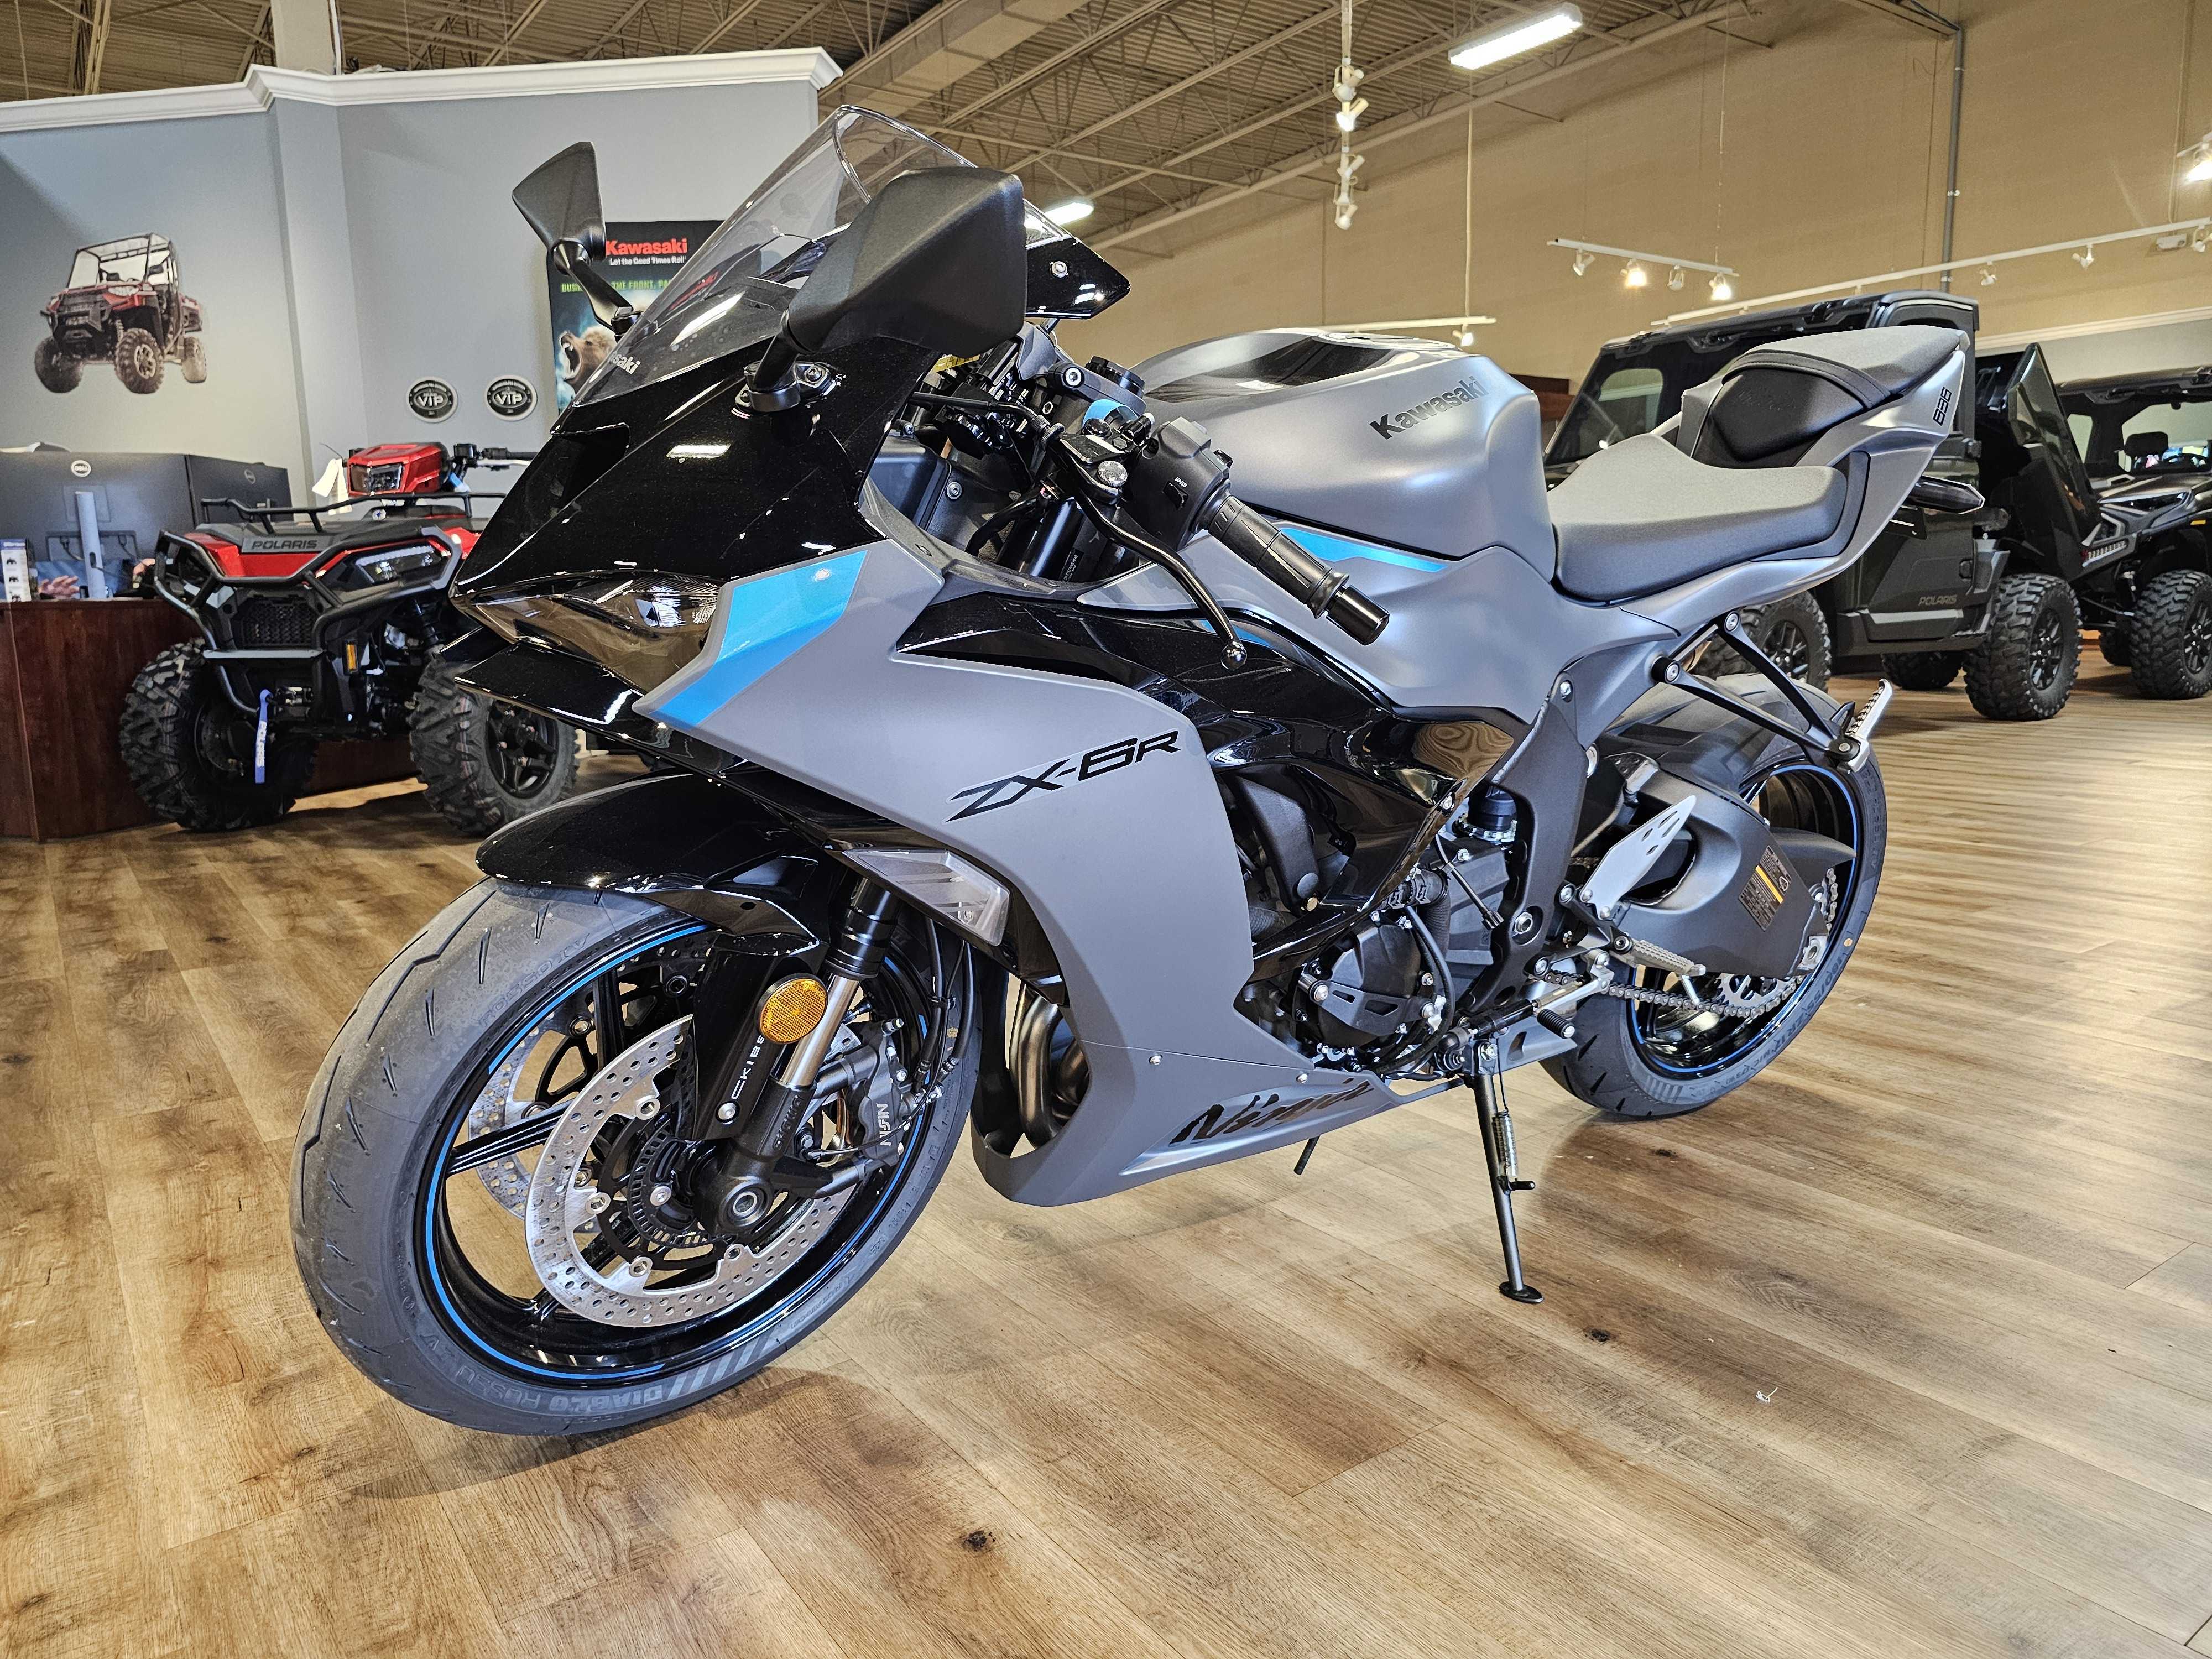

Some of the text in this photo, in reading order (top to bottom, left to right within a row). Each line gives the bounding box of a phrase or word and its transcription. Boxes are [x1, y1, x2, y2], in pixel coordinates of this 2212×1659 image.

[606, 238, 687, 256] Kawasaki
[621, 257, 632, 265] the
[418, 395, 444, 406] VIP
[496, 393, 523, 405] VIP
[1933, 387, 1952, 426] 636
[1369, 376, 1489, 440] Kawasaki
[1175, 477, 1187, 488] PASS
[252, 540, 317, 550] POLARIS
[1918, 594, 1958, 607] POLARIS
[945, 730, 1181, 823] ZX-6R
[1168, 1077, 1375, 1146] Ninja
[549, 1384, 663, 1413] DIABLO
